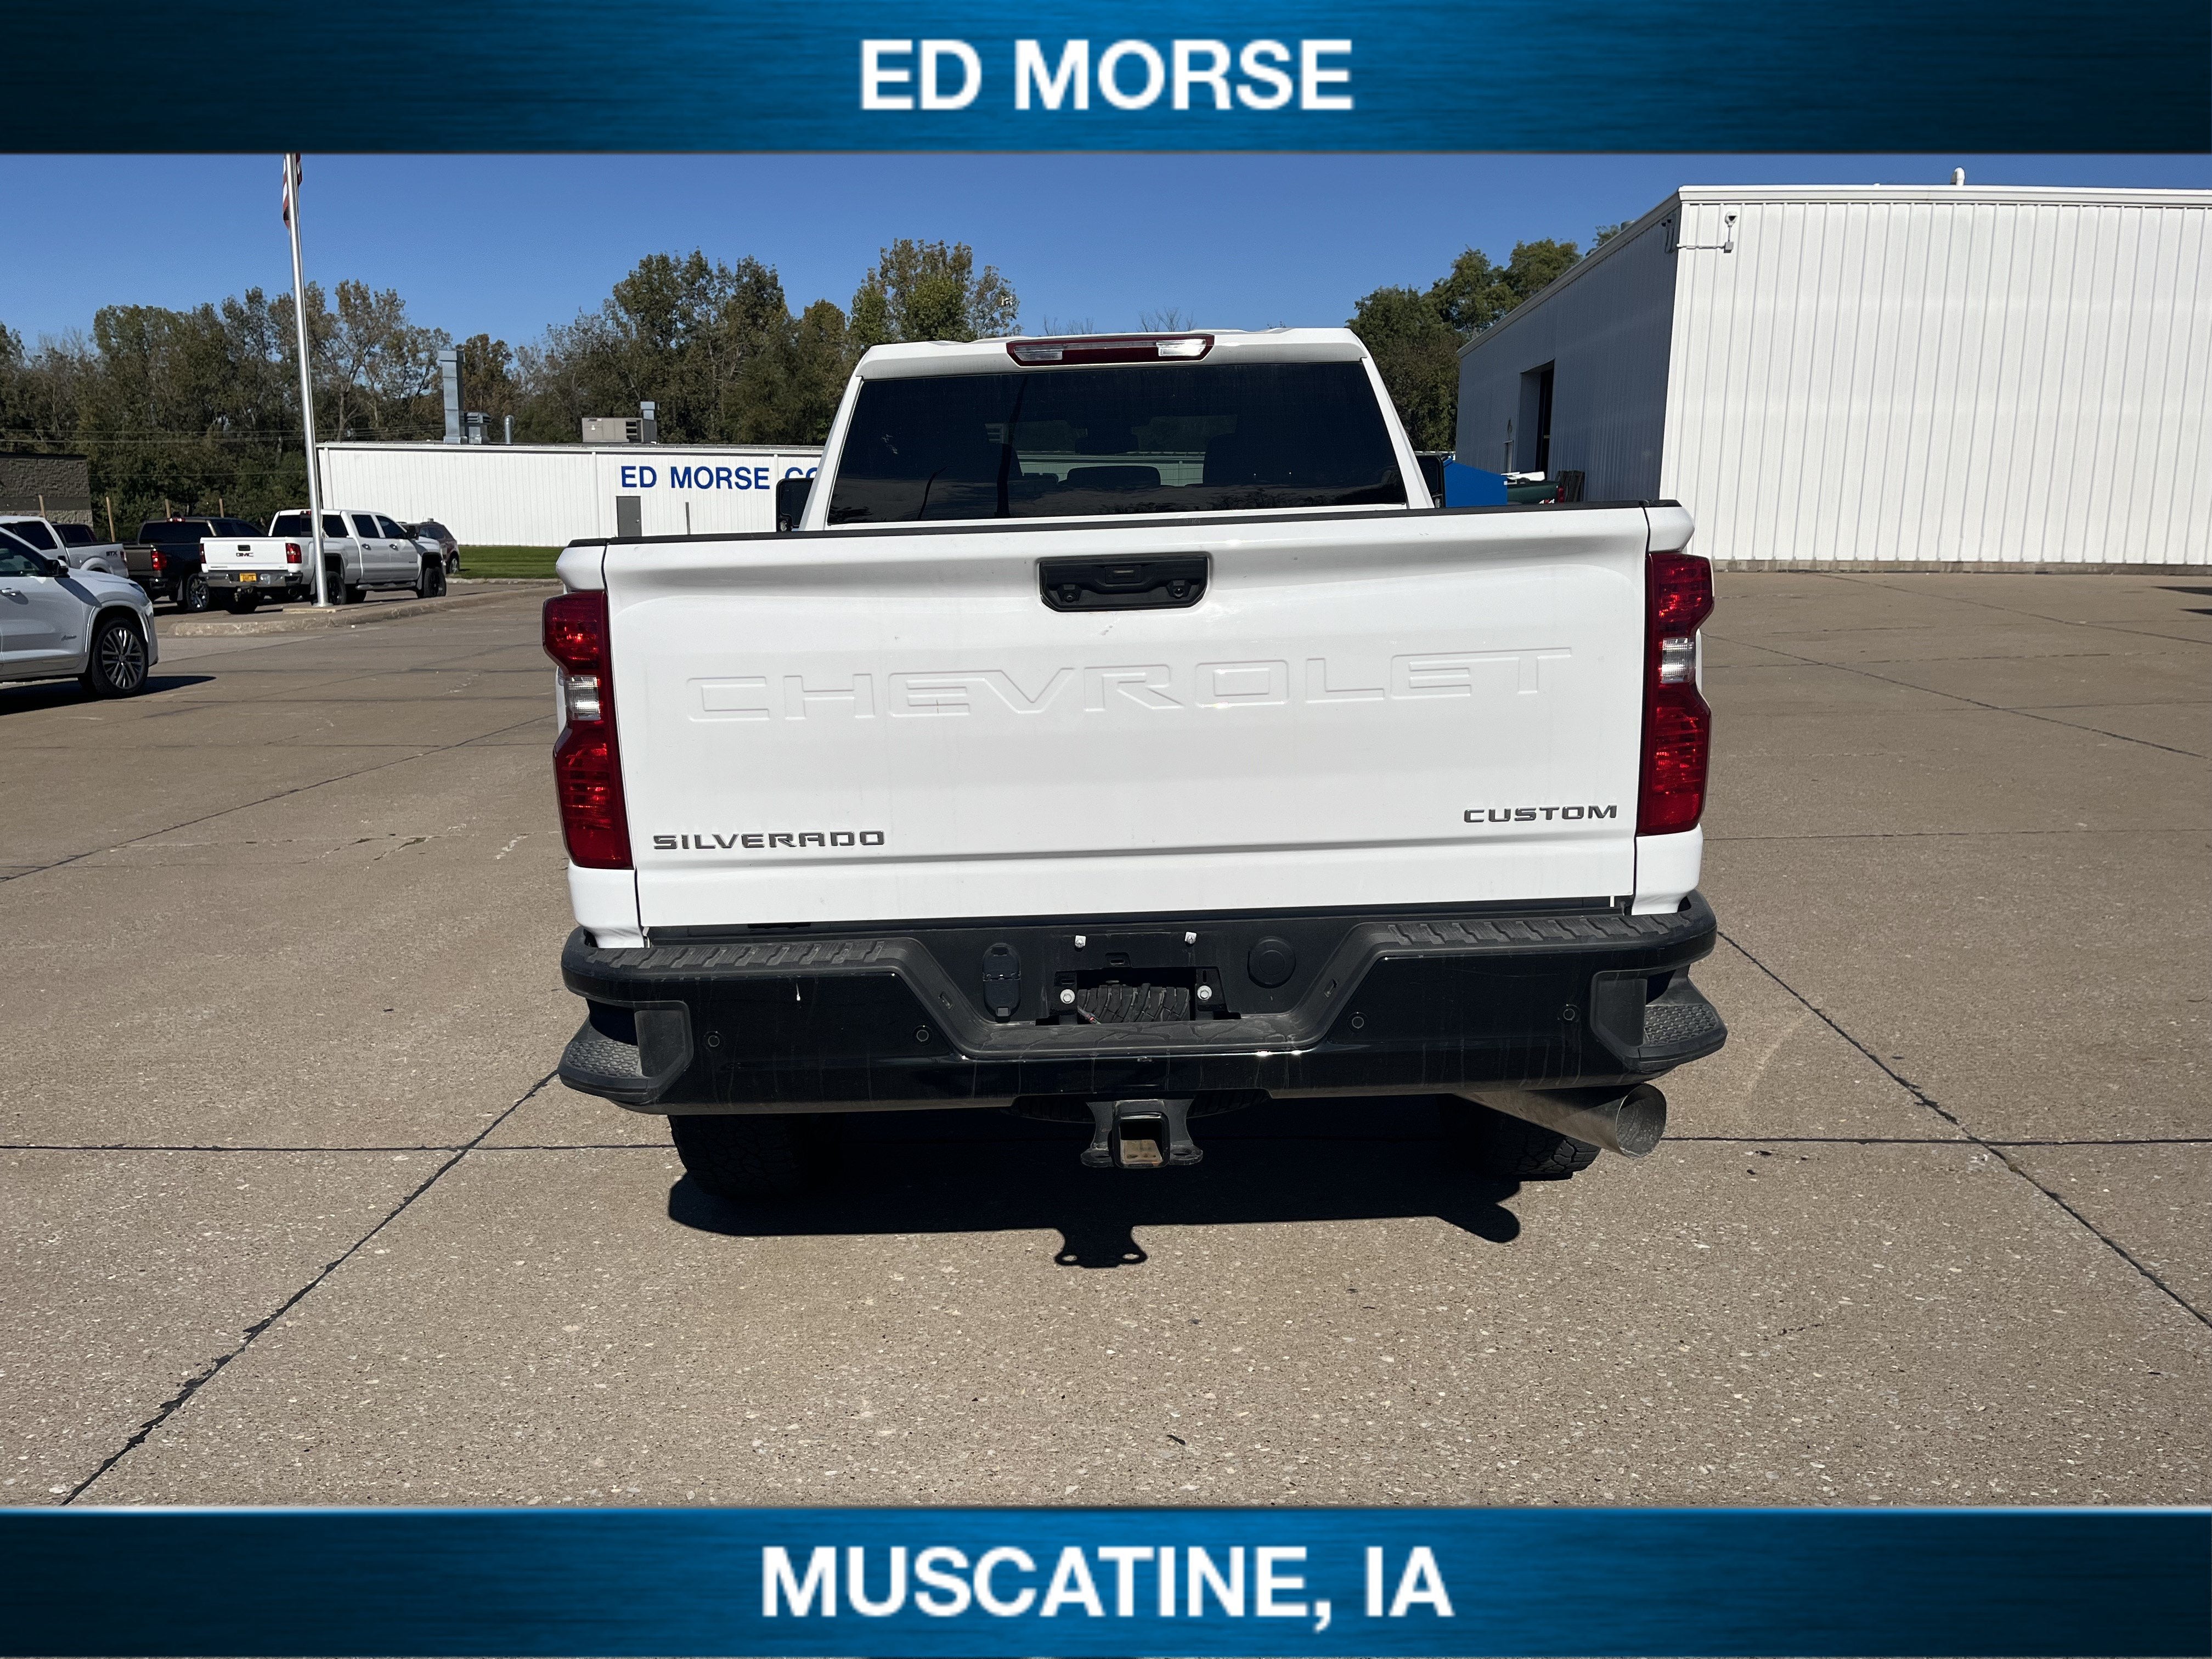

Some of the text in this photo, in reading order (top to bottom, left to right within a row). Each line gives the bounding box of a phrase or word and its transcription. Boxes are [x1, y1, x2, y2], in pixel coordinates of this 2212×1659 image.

[621, 466, 657, 488] ED
[671, 466, 770, 490] MORSE
[686, 647, 1572, 721] CHEVROLET
[1464, 804, 1618, 823] CUSTOM
[653, 830, 885, 850] SILVERADO
